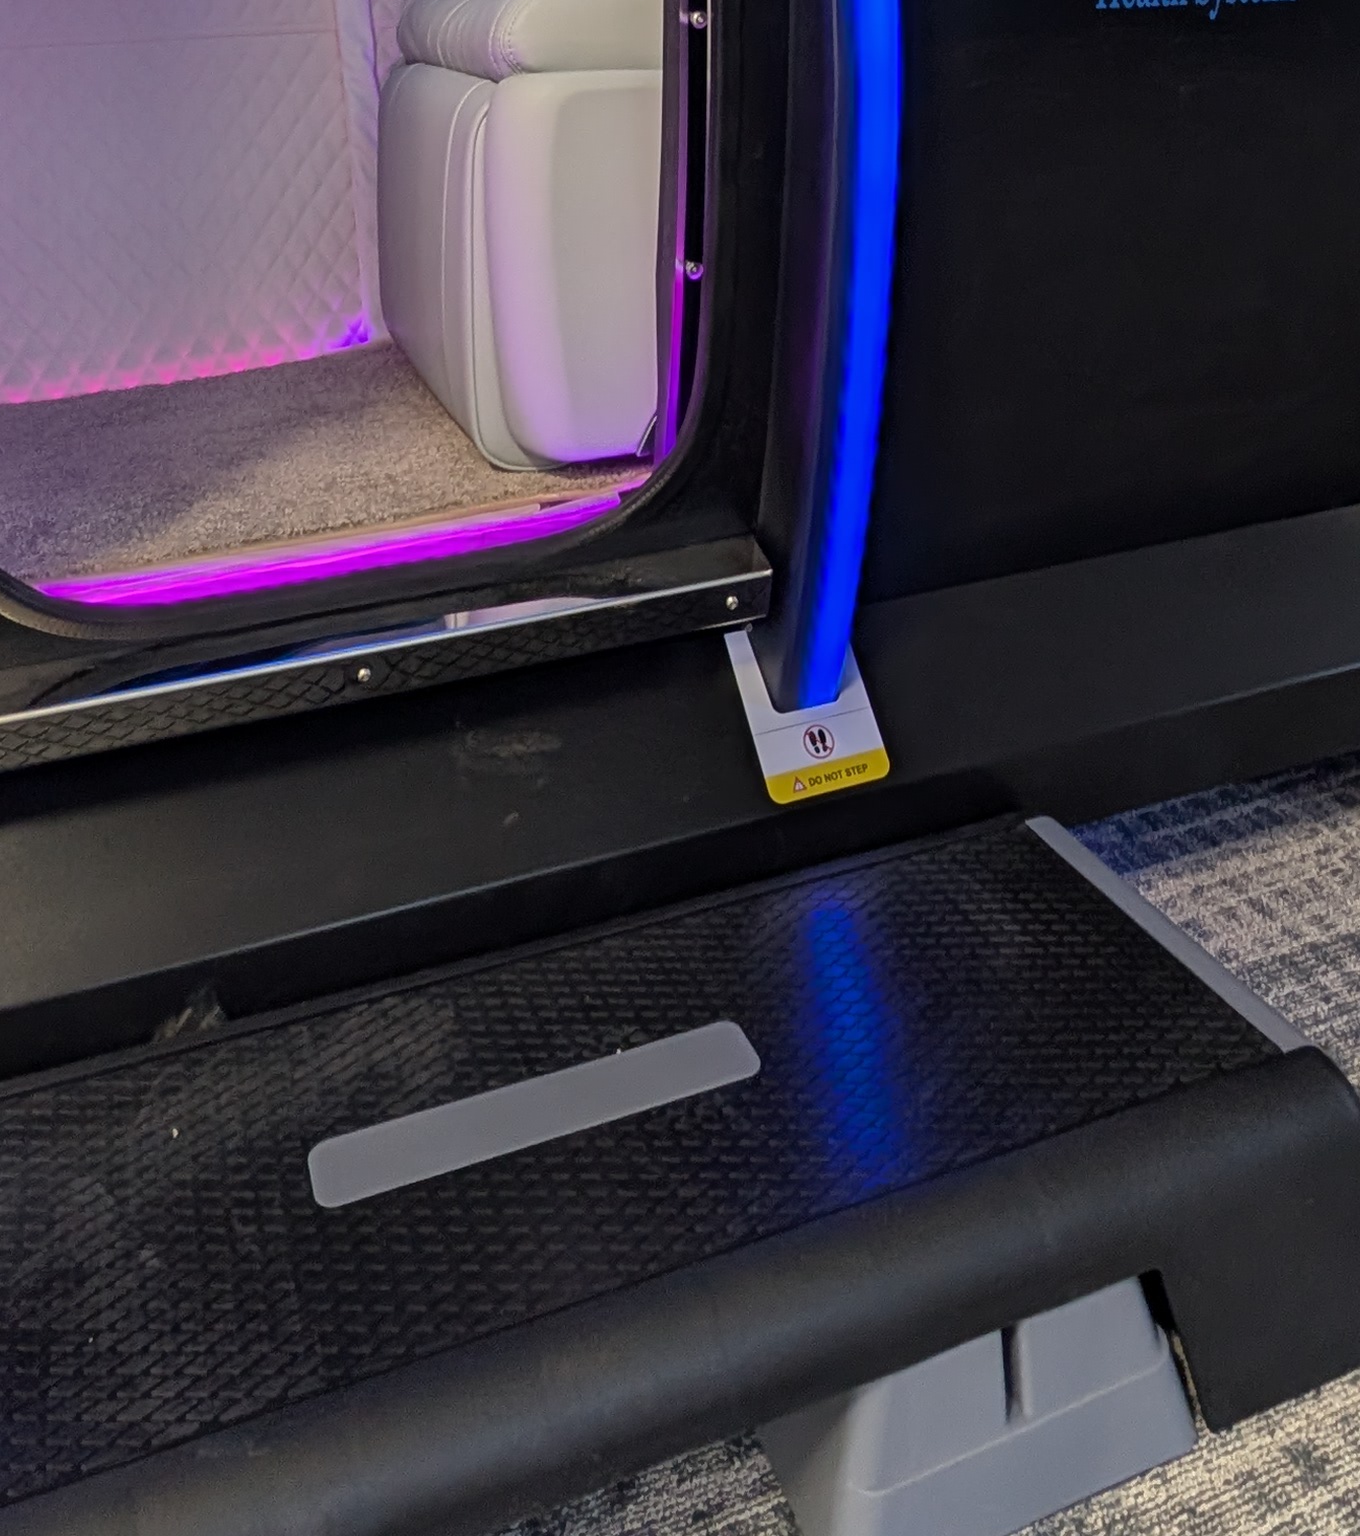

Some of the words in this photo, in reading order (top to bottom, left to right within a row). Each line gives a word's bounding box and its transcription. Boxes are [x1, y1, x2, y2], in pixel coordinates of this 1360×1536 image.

[808, 775, 823, 788] DO
[825, 771, 843, 783] NOT
[845, 763, 868, 778] STEP
